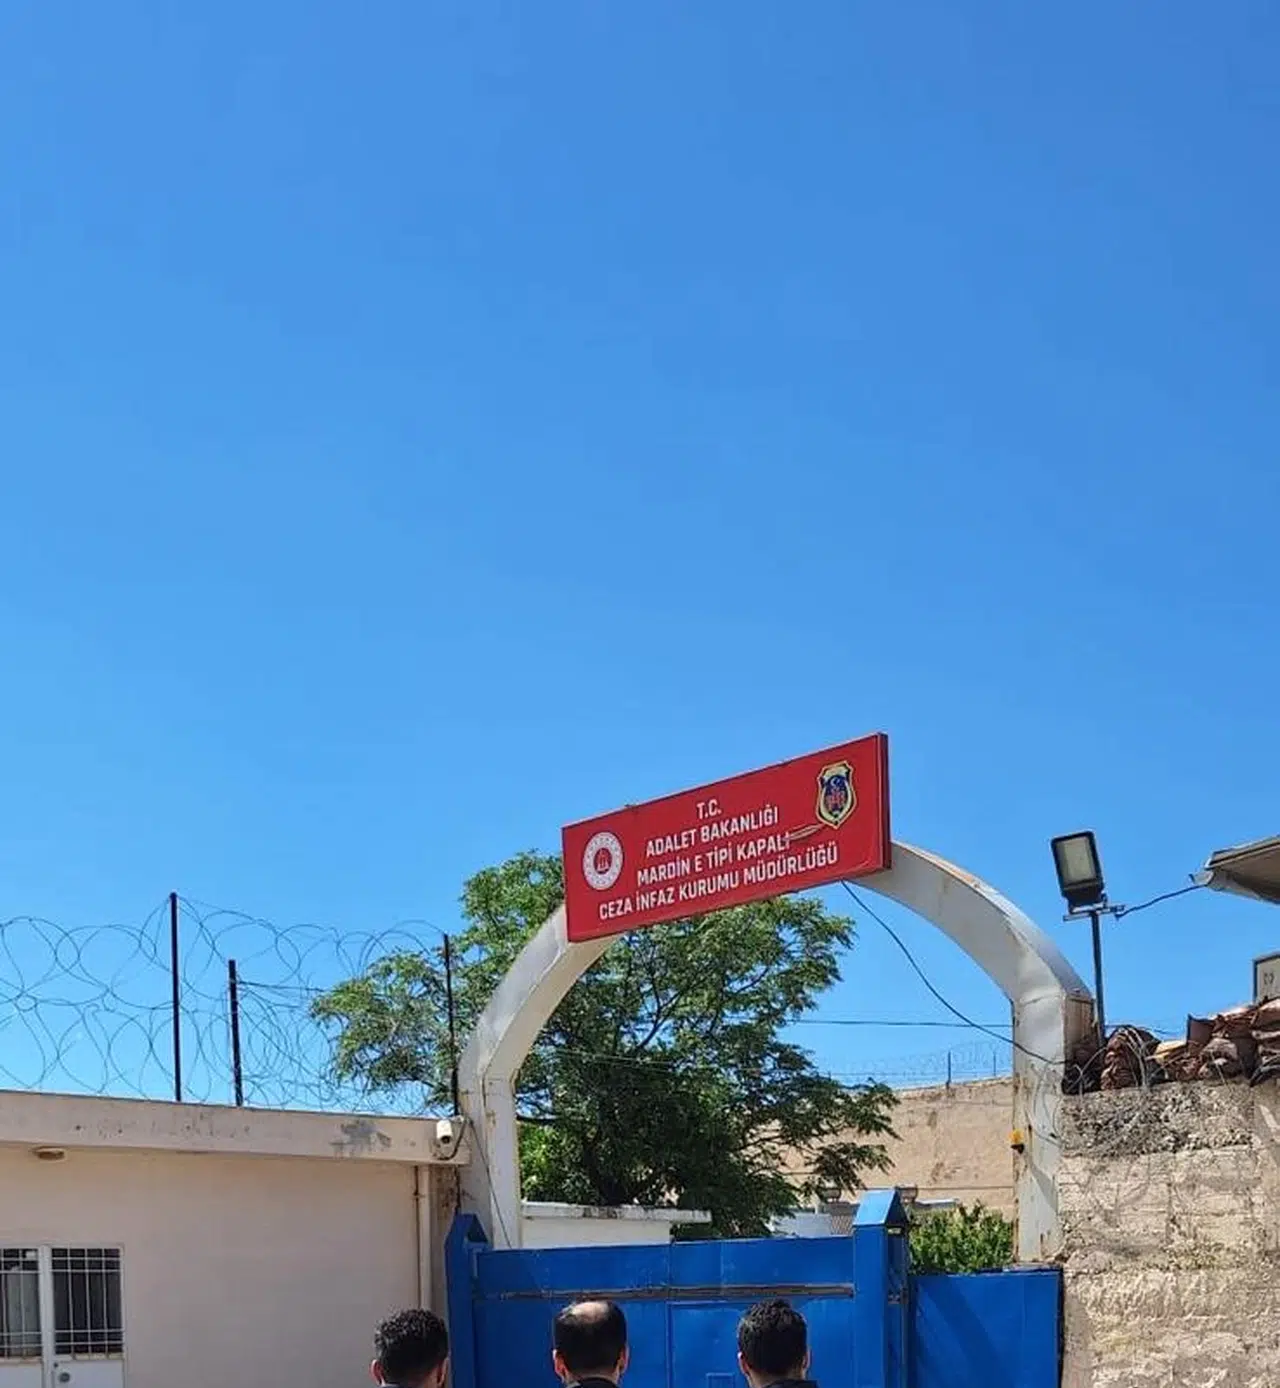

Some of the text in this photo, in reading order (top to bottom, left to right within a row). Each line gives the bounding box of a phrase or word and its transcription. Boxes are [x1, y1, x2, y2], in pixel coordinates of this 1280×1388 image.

[646, 804, 779, 858] ADALET BAKANLIĞI
[696, 799, 722, 820] T.C.
[599, 840, 838, 921] CEZA İNFAZ KURUMU MÜDÜRLÜĞÜ
[637, 831, 791, 887] MARDİN E TİPİ KAPALI
